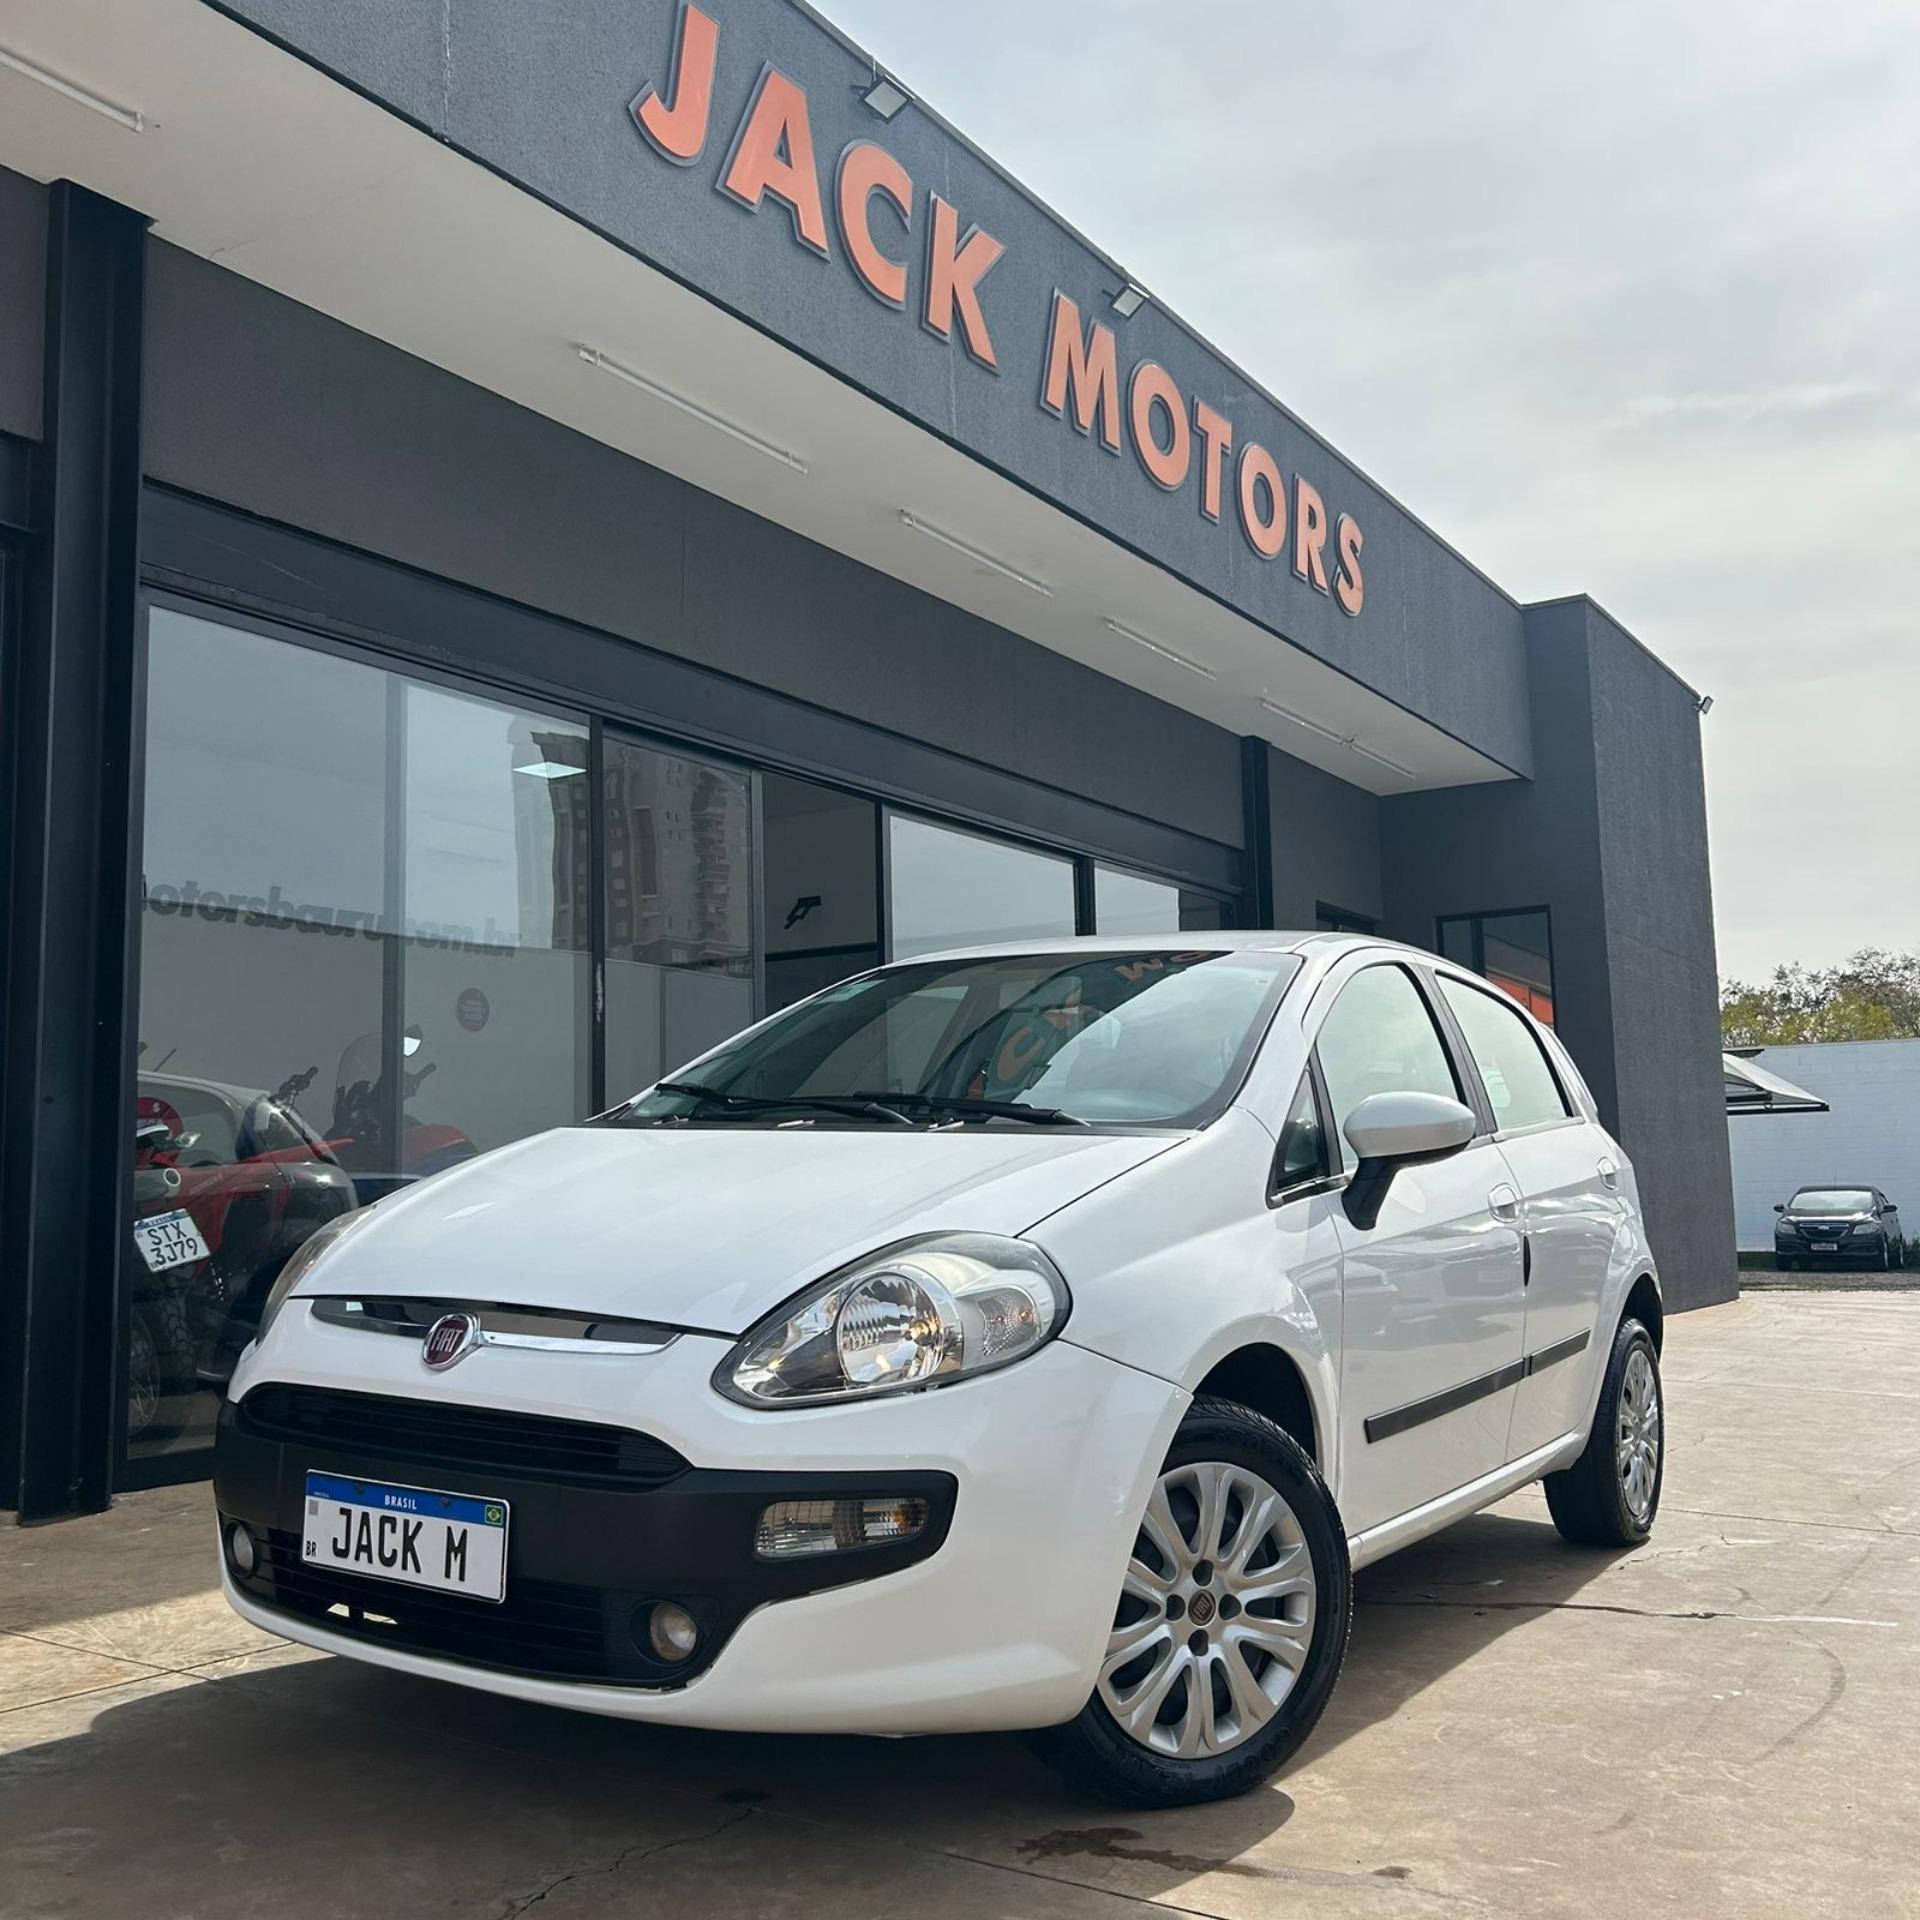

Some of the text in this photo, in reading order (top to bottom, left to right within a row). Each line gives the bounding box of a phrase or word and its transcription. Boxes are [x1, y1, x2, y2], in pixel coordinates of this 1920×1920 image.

[630, 2, 1364, 616] JACK MOTORS
[147, 1221, 187, 1245] STX
[150, 1237, 198, 1265] 3J79
[431, 1327, 464, 1352] FIAT
[384, 1494, 417, 1510] BRASIL
[306, 1540, 317, 1558] BR
[332, 1507, 468, 1582] JACK M
